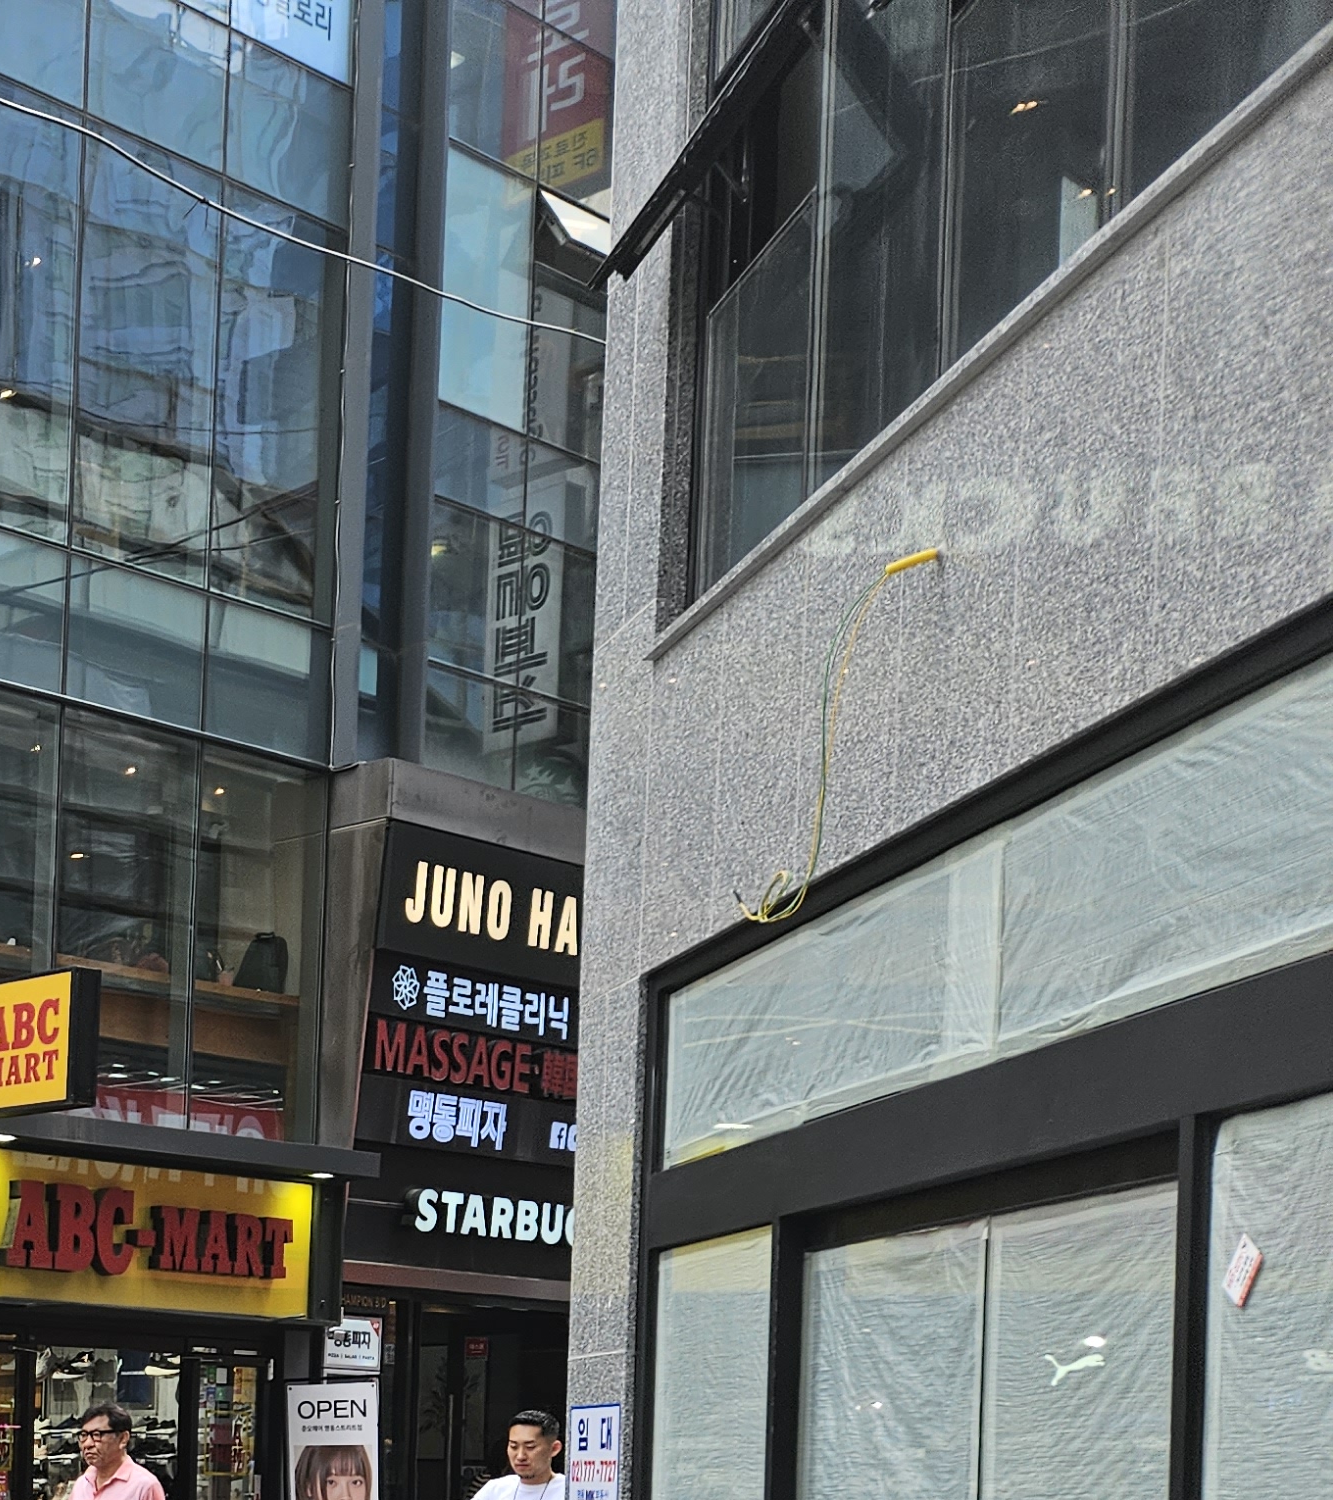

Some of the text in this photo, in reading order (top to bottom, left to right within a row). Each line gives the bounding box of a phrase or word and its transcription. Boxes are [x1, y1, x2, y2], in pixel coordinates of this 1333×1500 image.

[405, 860, 578, 957] JUNO HA
[423, 969, 570, 1040] 플로레클리닉
[373, 1018, 533, 1095] MASSAGE
[407, 1088, 508, 1151] 명동피자
[0, 1179, 294, 1279] ABC-MART
[414, 1189, 576, 1245] STARBU
[298, 1399, 367, 1420] OPEN
